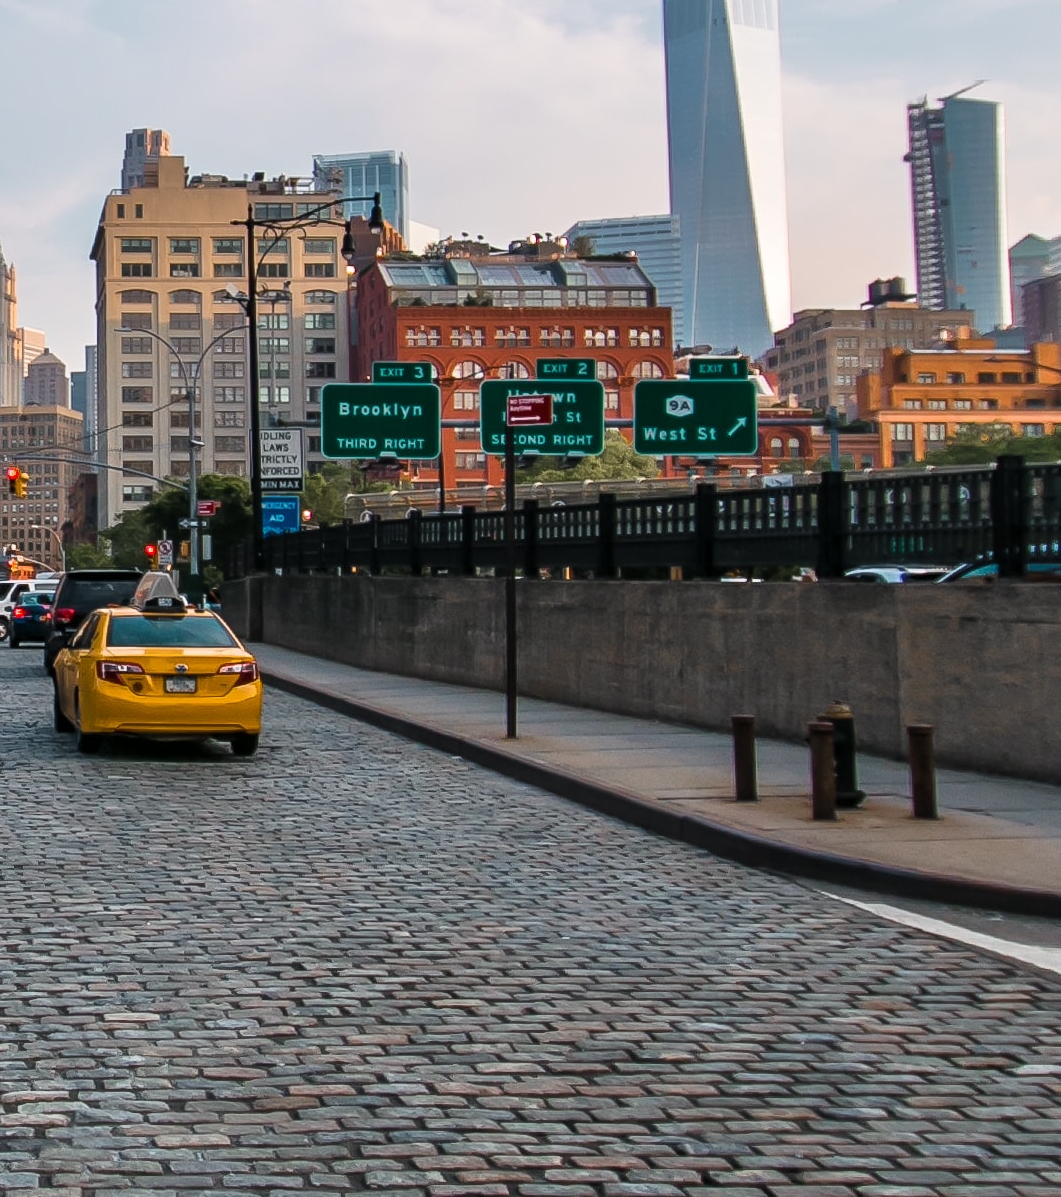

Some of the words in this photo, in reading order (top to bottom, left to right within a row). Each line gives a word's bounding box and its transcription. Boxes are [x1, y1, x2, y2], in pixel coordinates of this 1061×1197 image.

[379, 367, 404, 377] EXIT
[414, 366, 424, 379] 3
[543, 363, 568, 373] EXIT
[578, 362, 588, 375] 2
[699, 364, 723, 374] EXIT
[732, 362, 738, 375] 1
[339, 402, 422, 419] Brooklyn
[669, 400, 691, 411] 9A
[566, 411, 582, 423] St
[553, 434, 593, 445] RIGHT
[643, 427, 686, 441] West
[697, 427, 716, 441] St
[263, 443, 289, 452] LAWS
[337, 438, 377, 449] THIRD
[384, 438, 424, 449] RIGHT
[261, 455, 298, 464] TRICTLY
[261, 466, 300, 476] NFORCED
[261, 481, 277, 489] MIN
[279, 481, 300, 489] MAX
[269, 514, 285, 522] AID
